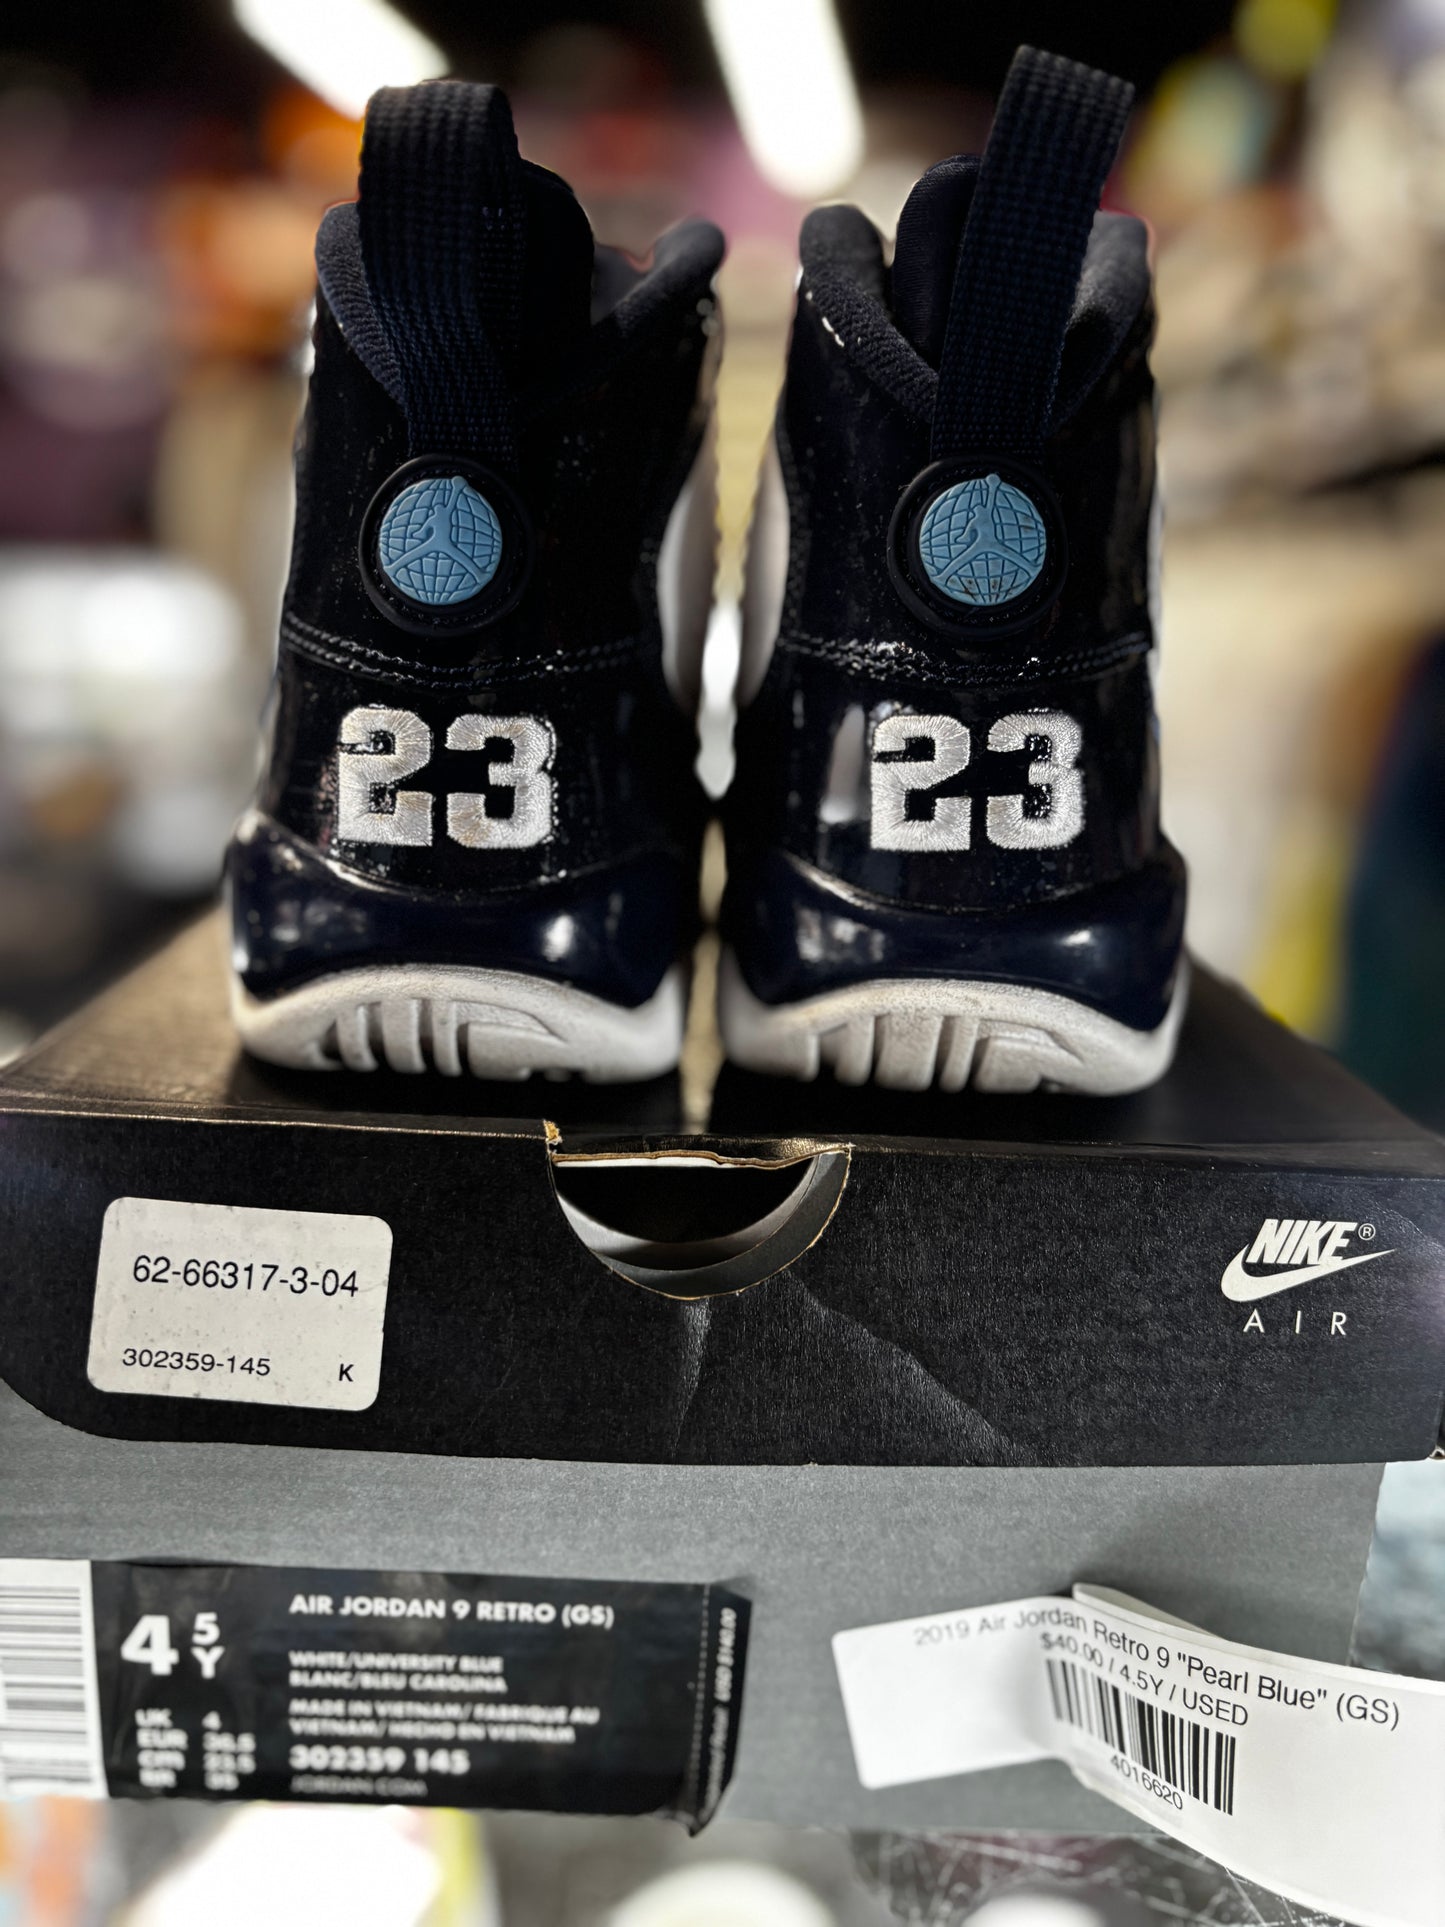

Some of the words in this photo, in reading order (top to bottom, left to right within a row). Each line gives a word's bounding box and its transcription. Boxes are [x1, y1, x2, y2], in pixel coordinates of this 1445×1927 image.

[338, 706, 556, 849] 23
[869, 712, 1085, 852] 23
[133, 1255, 359, 1297] 62-66317-3-04
[122, 1348, 271, 1376] 302359-145
[338, 1364, 354, 1382] K
[191, 1611, 221, 1646] 5
[289, 1594, 333, 1615] AIR
[339, 1596, 446, 1619] JORDAN
[452, 1600, 471, 1620] 9
[476, 1601, 556, 1624] RETRO
[561, 1603, 615, 1630] (GS)
[120, 1614, 180, 1676] 4
[190, 1645, 226, 1680] Y
[289, 1651, 457, 1672] WHITE/UNIVERSITY
[459, 1655, 504, 1674] BLUE
[409, 1673, 508, 1693] CAROLINA
[914, 1620, 970, 1646] 2019
[978, 1615, 1005, 1634] Air
[1013, 1607, 1088, 1634] Jordan
[1093, 1620, 1150, 1661] Retro
[1156, 1646, 1170, 1668] 9
[1177, 1652, 1248, 1694] "Pearl
[1257, 1675, 1327, 1711] Blue"
[1336, 1692, 1400, 1732] (GS)
[1040, 1631, 1104, 1668] $40.00
[1119, 1664, 1164, 1696] 4.5Y
[1182, 1687, 1249, 1727] USED
[135, 1708, 173, 1729] UK
[289, 1698, 345, 1717] MADE
[348, 1699, 373, 1718] IN
[136, 1728, 189, 1750] EUR
[289, 1744, 406, 1773] 302359
[413, 1748, 471, 1775] 145
[1110, 1754, 1183, 1811] 4016620
